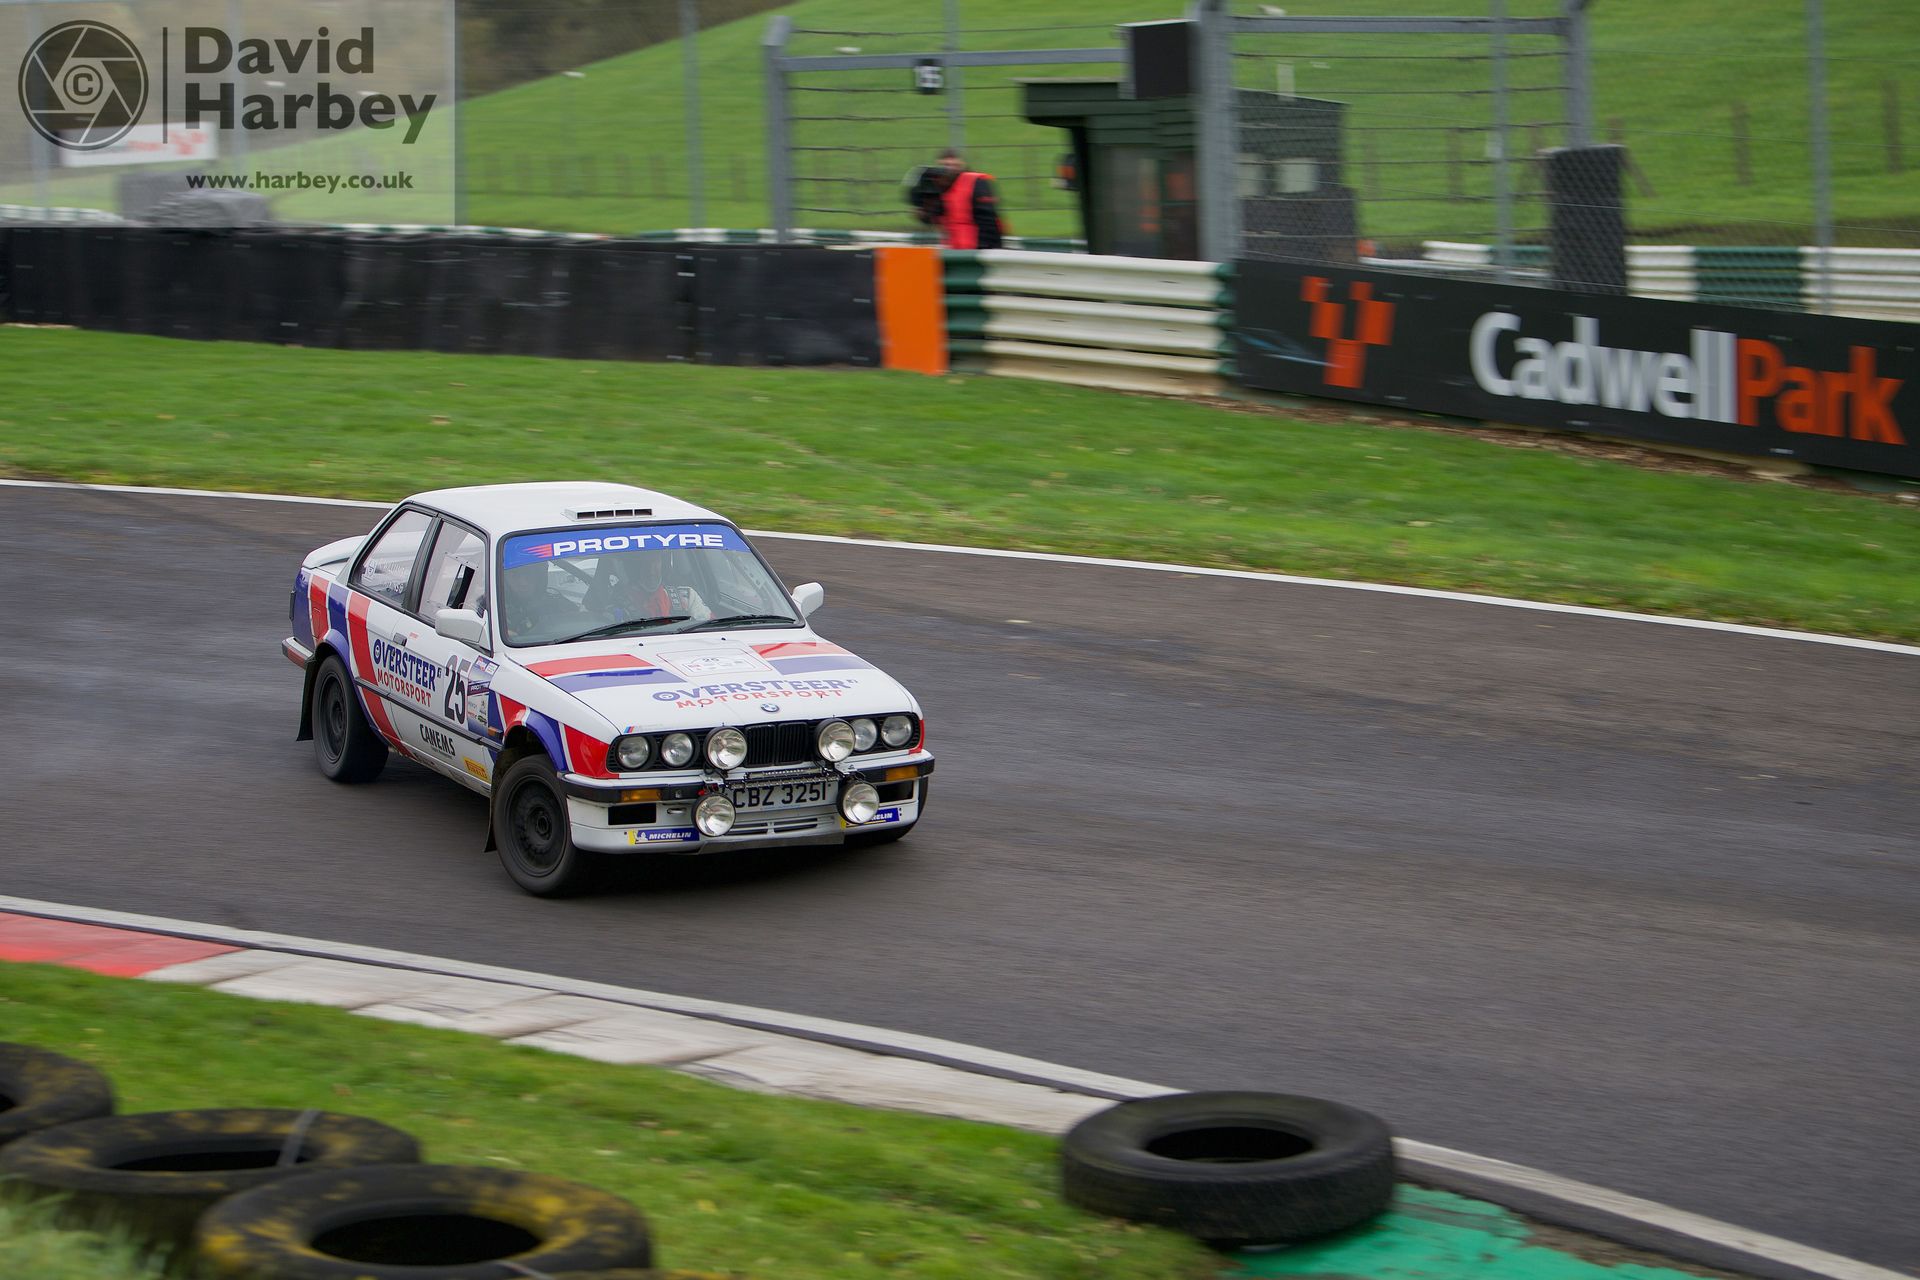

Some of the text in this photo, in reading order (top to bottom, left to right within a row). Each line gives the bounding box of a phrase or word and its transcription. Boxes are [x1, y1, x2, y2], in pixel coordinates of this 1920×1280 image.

[553, 534, 723, 556] PROTYRE
[373, 638, 436, 692] OVERSTEER
[377, 668, 432, 708] MOTORSPORT
[444, 655, 472, 725] 25
[652, 678, 852, 702] OVERSTEER
[675, 689, 843, 709] MOTORSPORT
[419, 723, 456, 757] CANEMS
[733, 785, 775, 808] CBZ
[648, 831, 692, 840] MICHELIN
